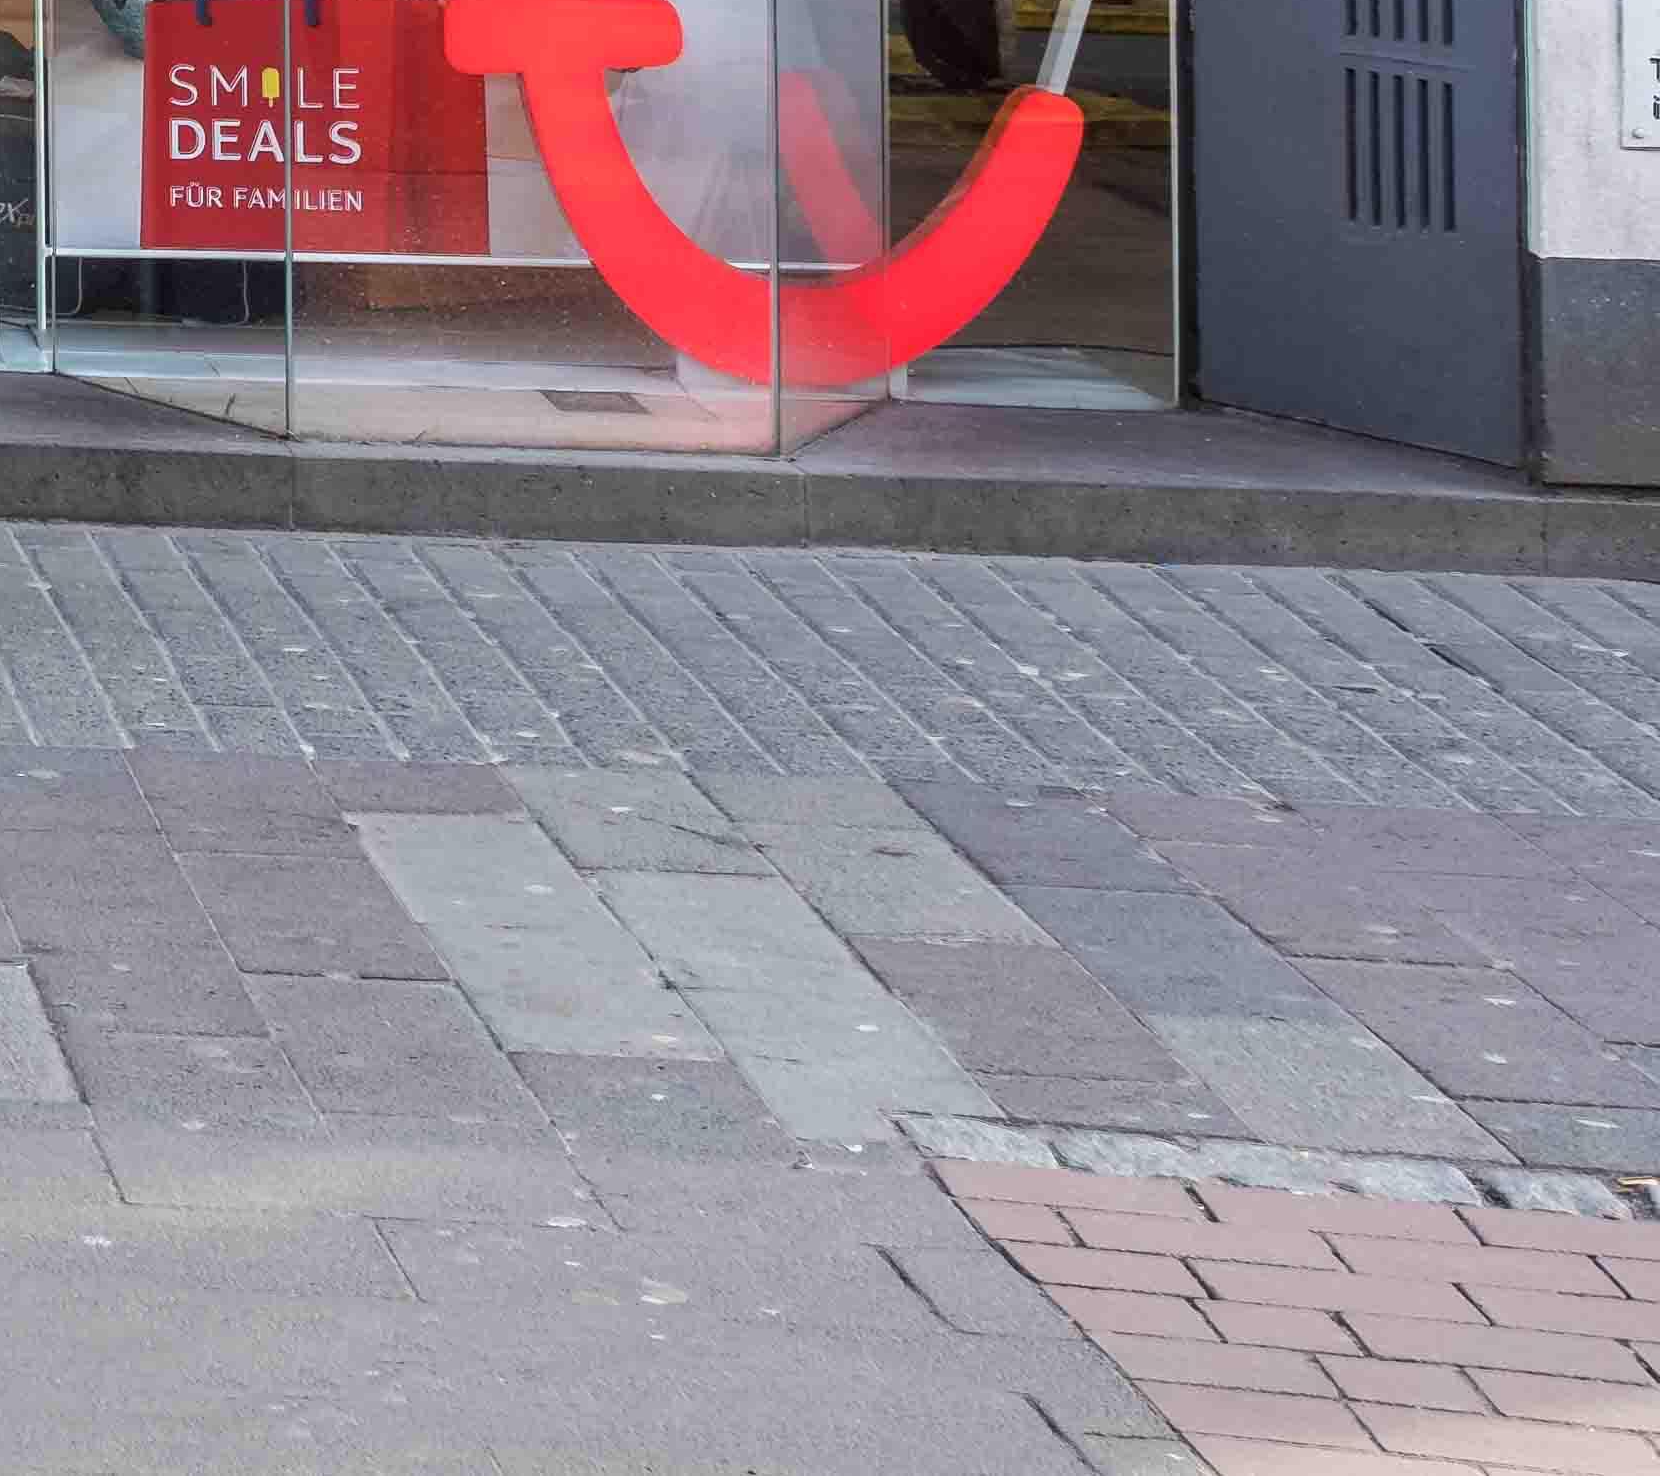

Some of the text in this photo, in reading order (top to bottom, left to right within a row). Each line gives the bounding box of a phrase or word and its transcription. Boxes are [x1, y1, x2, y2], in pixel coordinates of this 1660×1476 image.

[168, 118, 363, 166] DEALS
[170, 180, 364, 214] FÜR FAMILIEN
